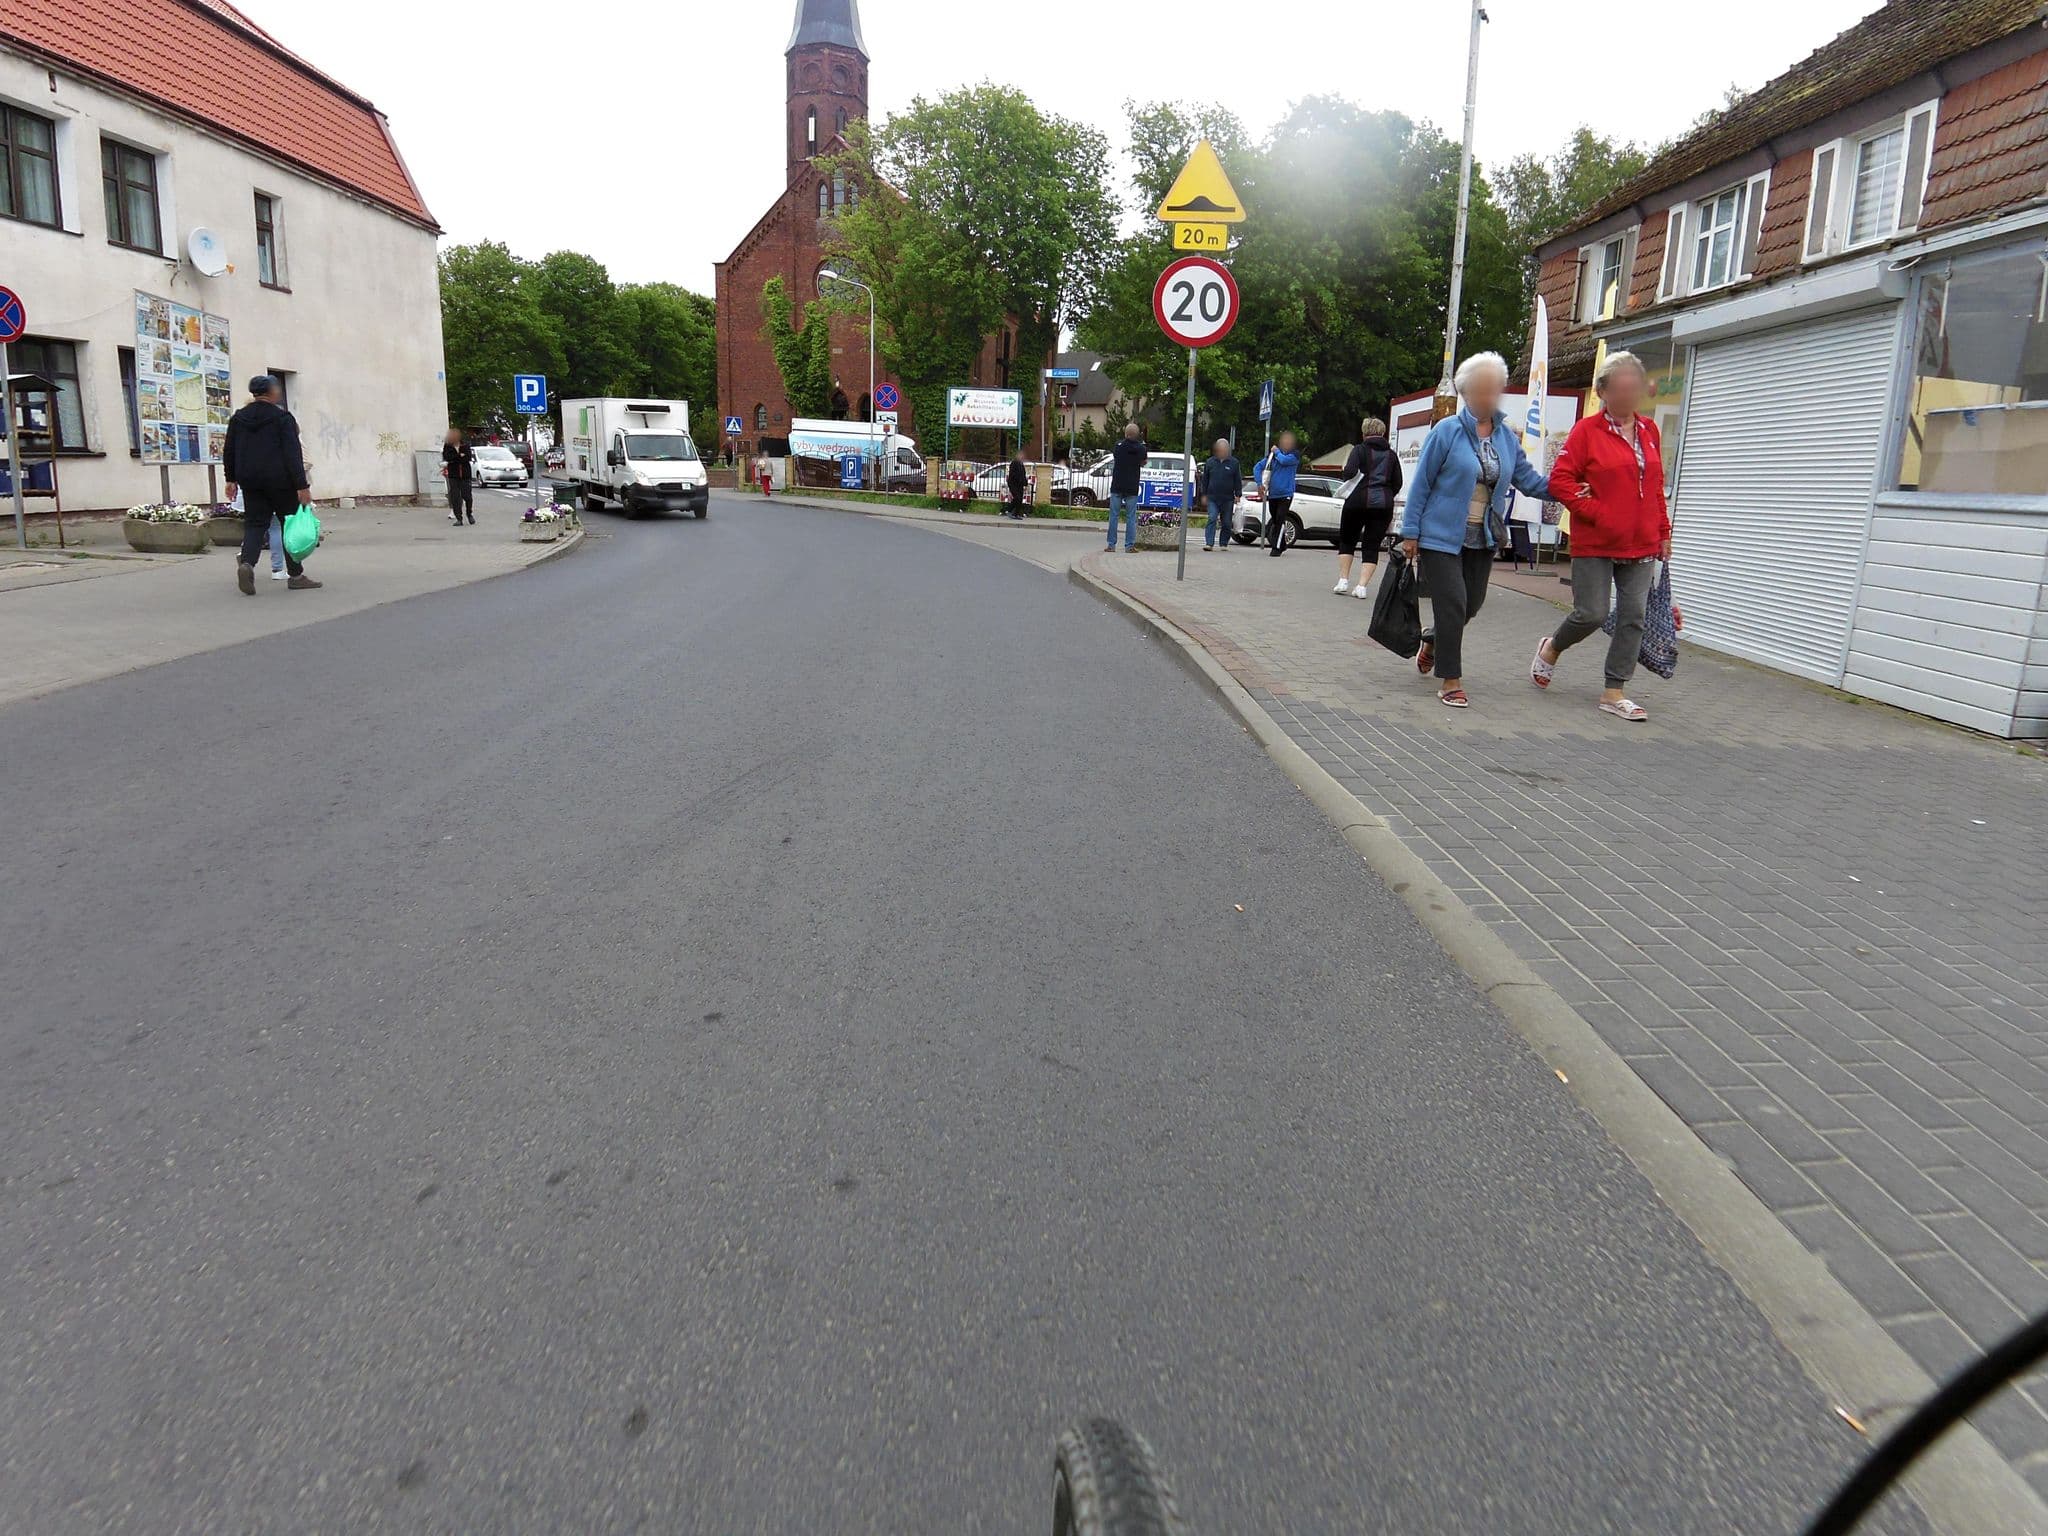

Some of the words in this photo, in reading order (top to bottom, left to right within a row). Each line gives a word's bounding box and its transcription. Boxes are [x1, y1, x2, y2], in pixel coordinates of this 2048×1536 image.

[1182, 228, 1204, 244] 20
[1207, 236, 1219, 245] m
[1170, 280, 1226, 323] 20
[521, 379, 539, 402] P
[952, 413, 1017, 425] JAGODA
[792, 440, 814, 453] ryby
[848, 461, 855, 475] P
